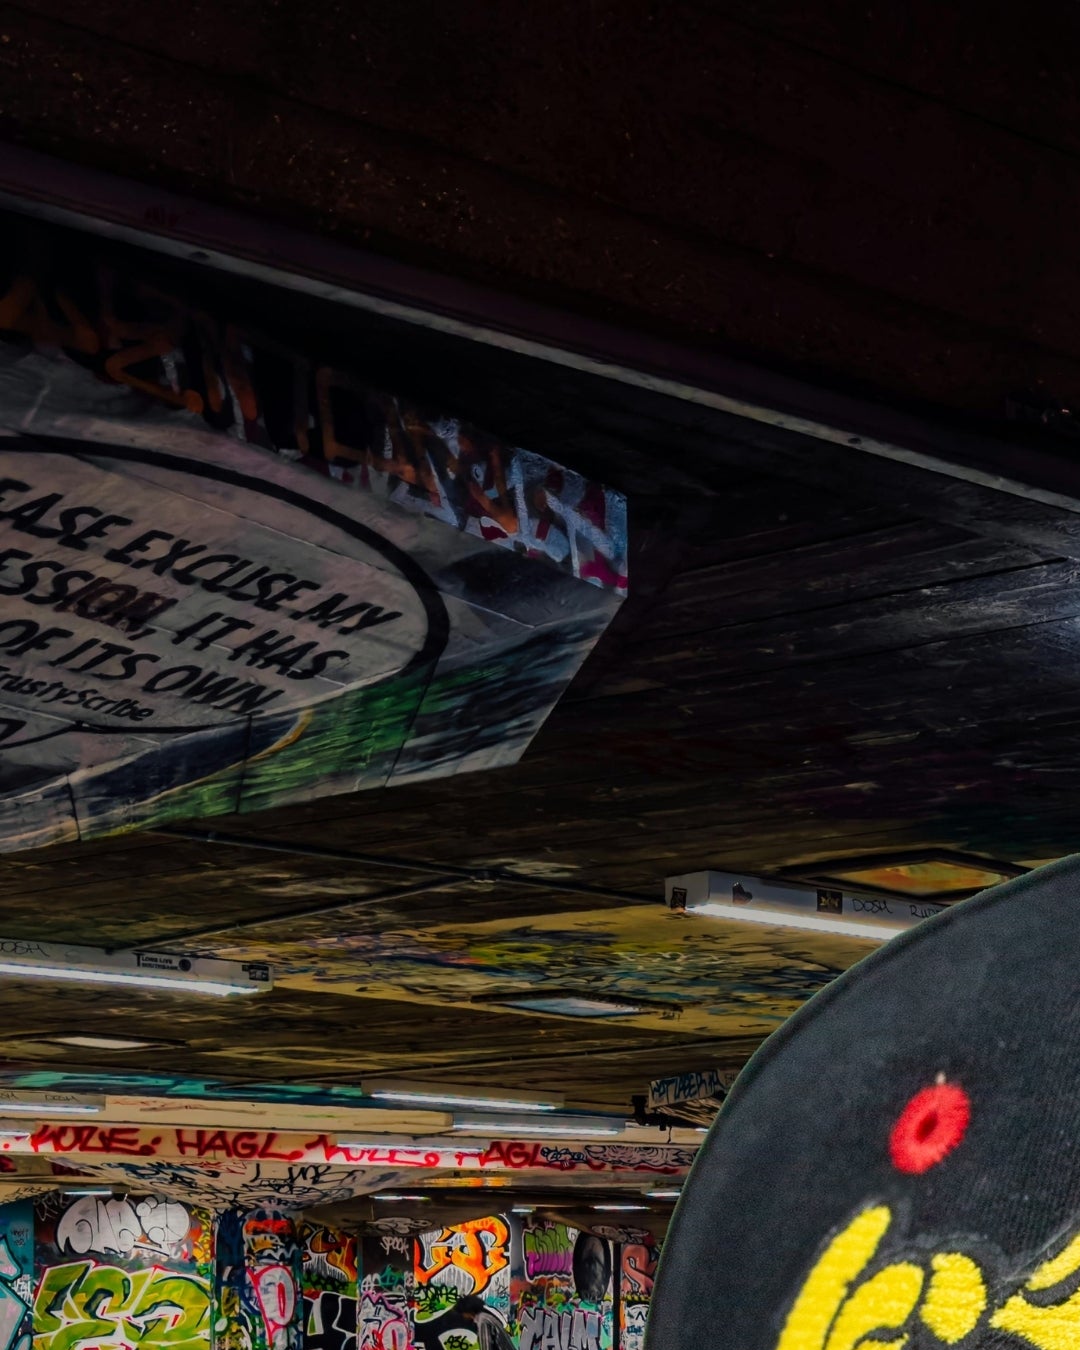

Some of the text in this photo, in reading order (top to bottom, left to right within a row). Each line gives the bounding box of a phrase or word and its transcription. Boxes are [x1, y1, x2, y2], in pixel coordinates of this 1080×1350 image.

[104, 530, 320, 611] EXCUSE
[290, 592, 402, 635] MY
[0, 619, 73, 657] OF
[48, 638, 161, 681] ITS
[172, 612, 254, 651] IT
[228, 629, 350, 680] HAS
